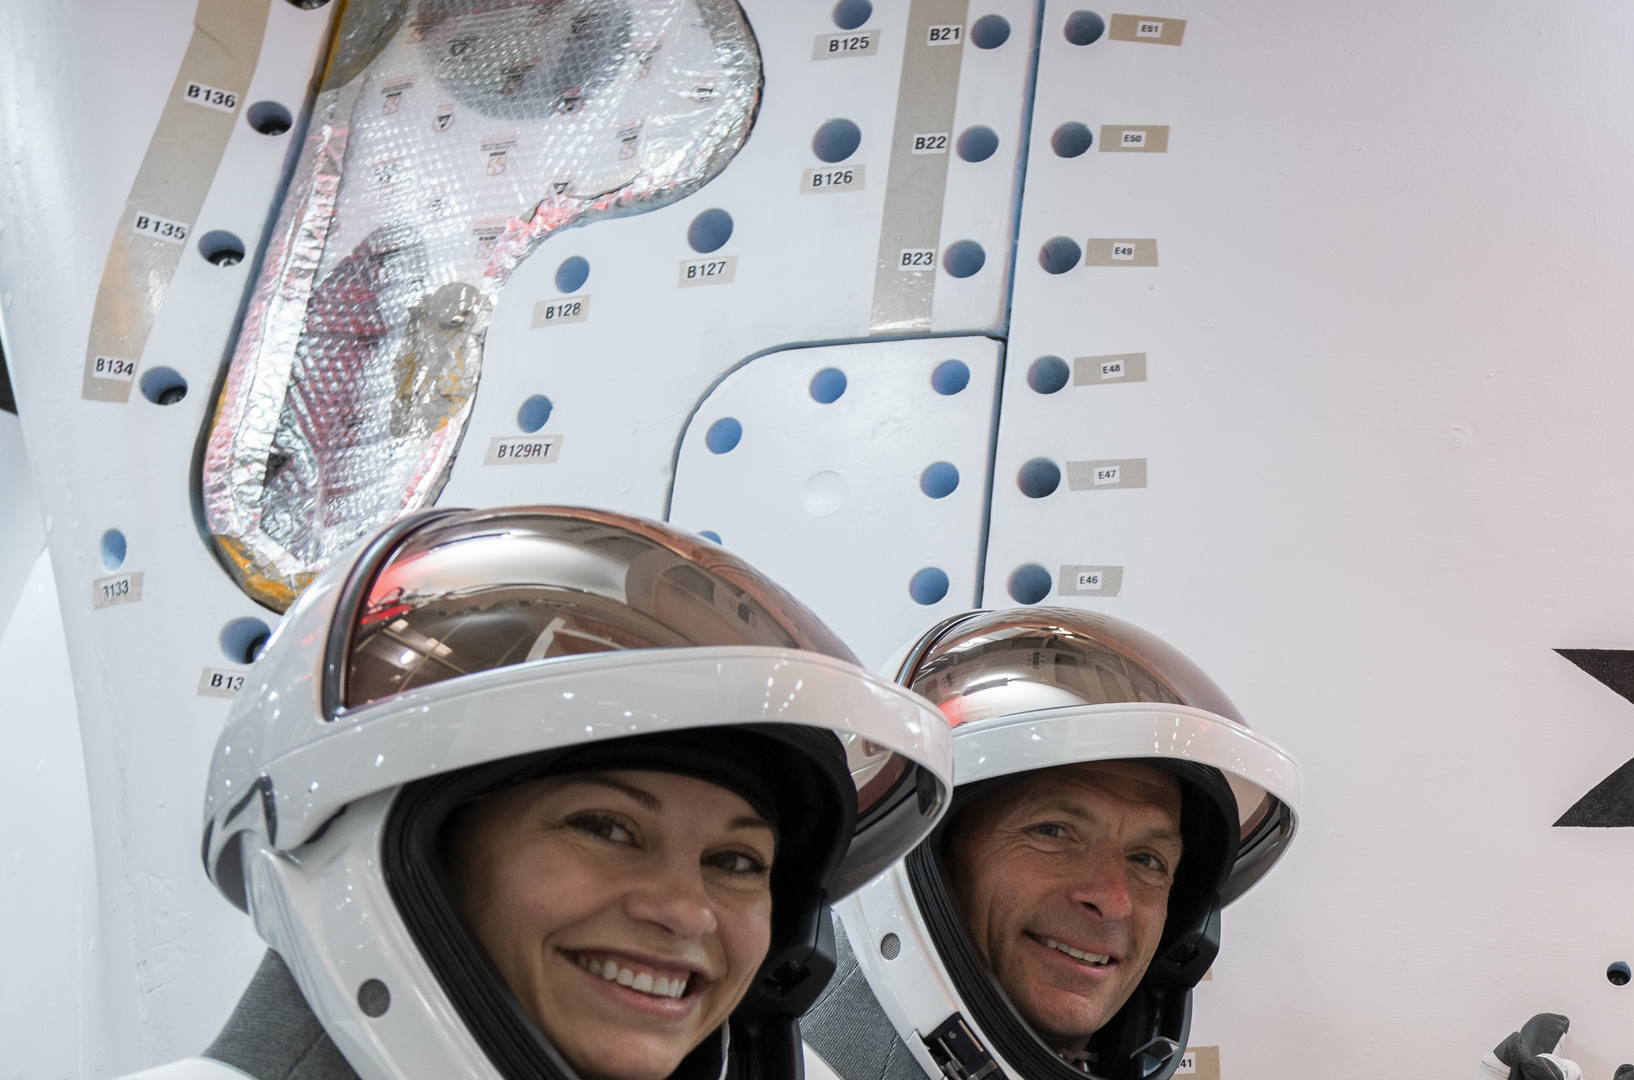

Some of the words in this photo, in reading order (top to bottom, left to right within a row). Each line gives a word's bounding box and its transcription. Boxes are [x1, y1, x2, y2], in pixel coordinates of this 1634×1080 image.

[930, 28, 959, 41] B21
[1141, 24, 1159, 33] E51
[829, 37, 869, 52] B125
[188, 85, 236, 107] B136
[915, 136, 946, 149] B22
[1124, 134, 1142, 143] E50
[812, 171, 852, 186] B126
[136, 216, 186, 239] B135
[1114, 246, 1133, 256] E49
[902, 252, 933, 265] B23
[687, 261, 726, 278] B127
[546, 302, 581, 320] B128
[96, 358, 134, 375] B134
[1102, 364, 1121, 374] E48
[498, 444, 552, 458] B129RT
[1098, 470, 1117, 480] E47
[1080, 575, 1098, 585] E46
[211, 674, 245, 690] B13
[1176, 1058, 1192, 1068] 41
